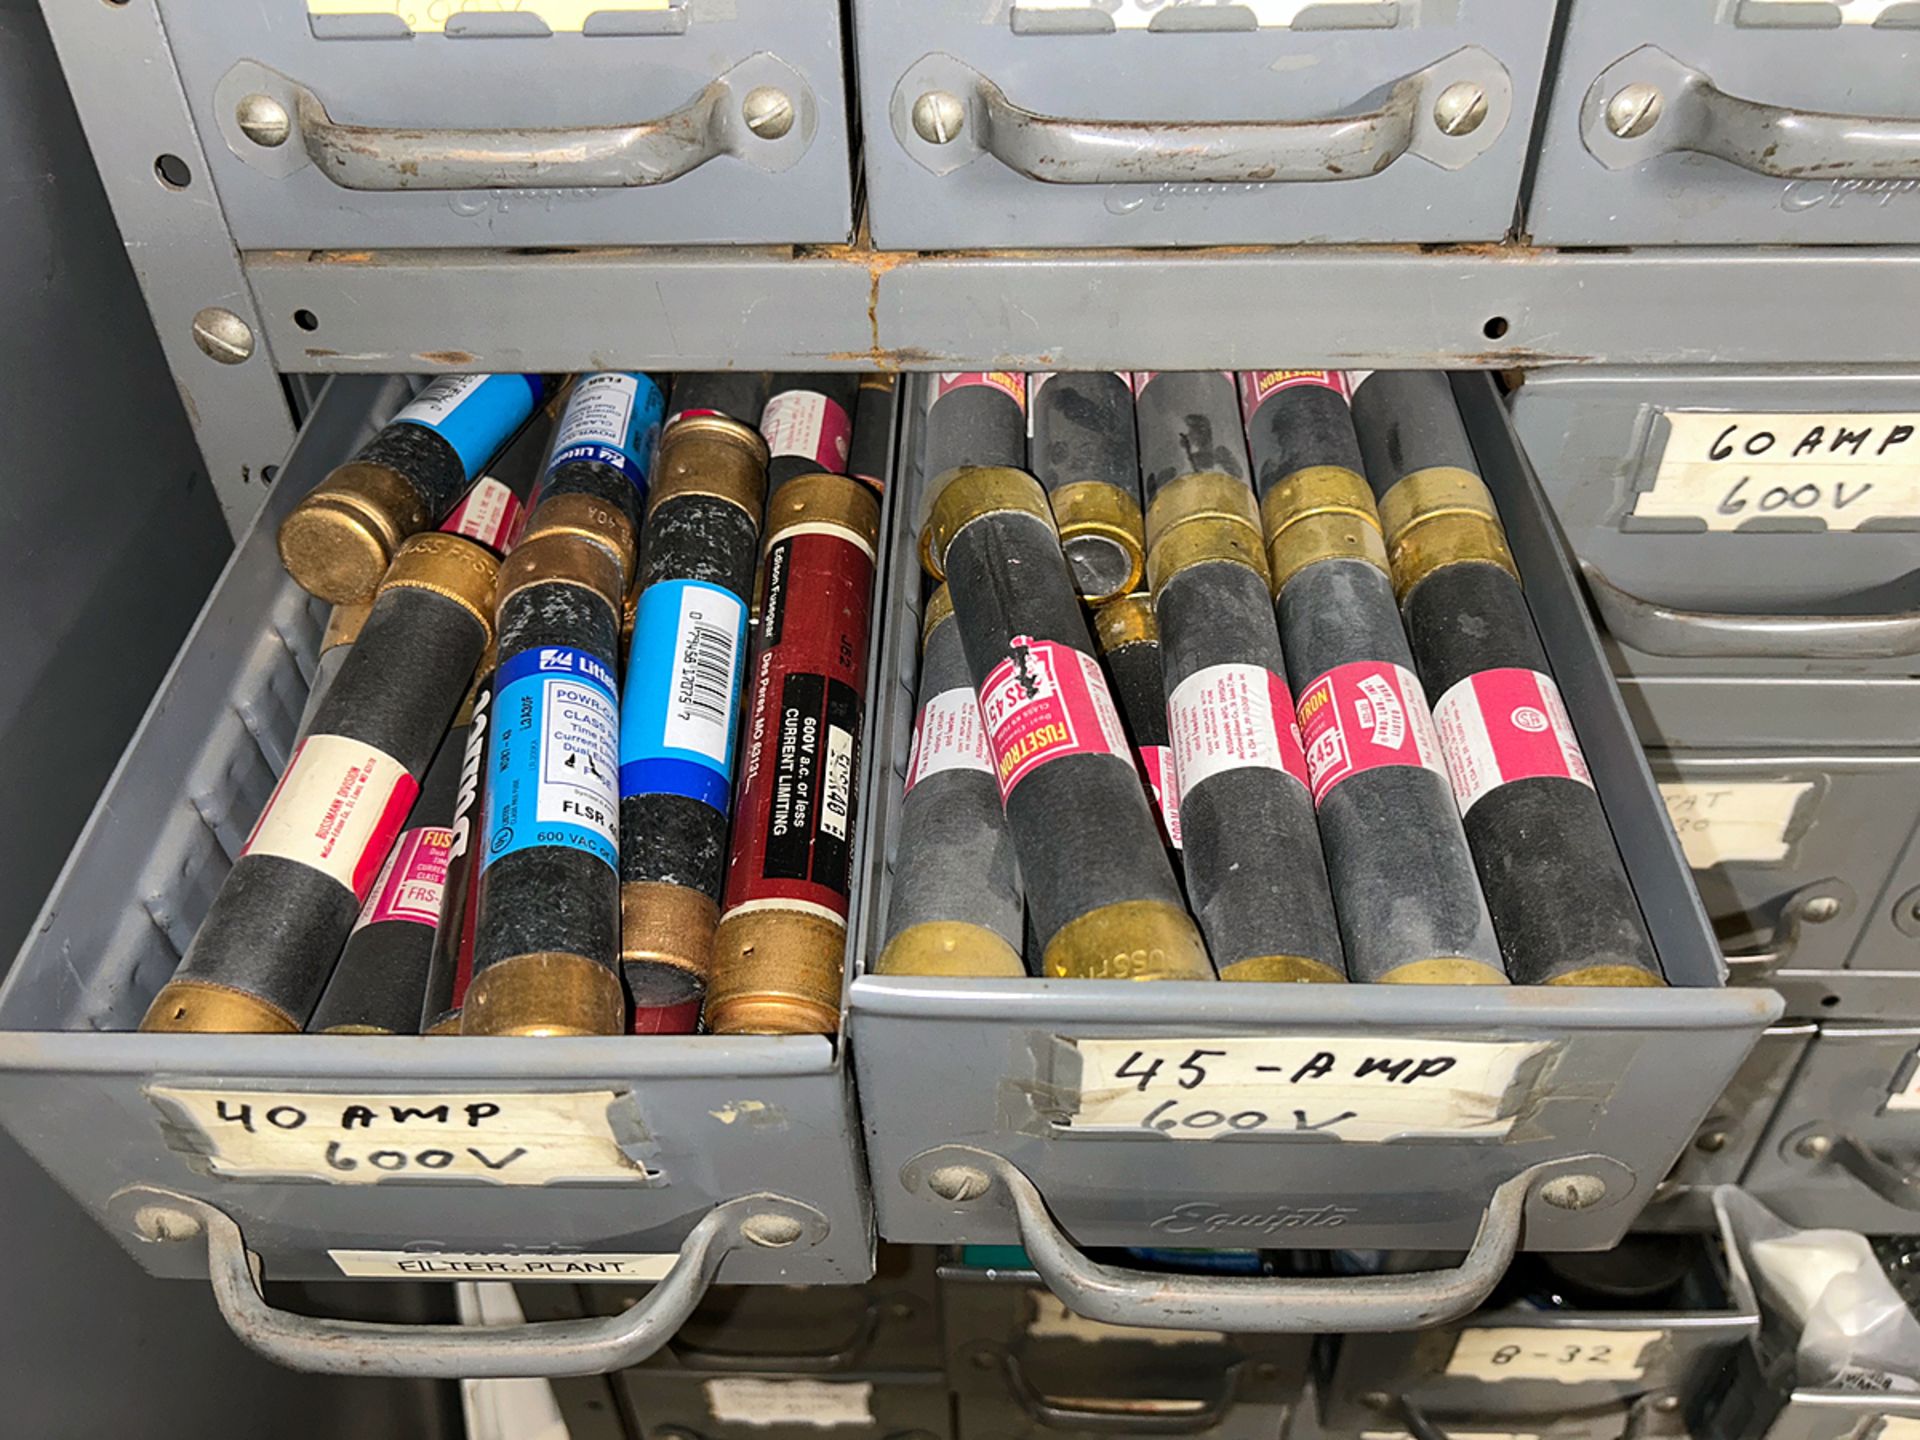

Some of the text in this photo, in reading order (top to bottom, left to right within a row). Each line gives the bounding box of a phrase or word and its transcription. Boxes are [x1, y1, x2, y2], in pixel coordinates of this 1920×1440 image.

[1709, 424, 1914, 461] 60 AMP
[764, 546, 785, 638] Edison Fusegear
[760, 652, 772, 677] Des
[1199, 688, 1207, 704] WITH
[1217, 677, 1227, 703] DIVISION
[563, 708, 606, 733] CLASS
[988, 698, 1003, 726] 45
[1201, 707, 1210, 733] REPLACE
[1206, 688, 1220, 749] AN ORDINARY FUSE
[554, 731, 598, 751] Current
[570, 723, 599, 740] Time
[1223, 721, 1234, 755] BUSSMANN
[563, 742, 590, 756] Dual
[998, 721, 1067, 778] FUSETRON
[1314, 735, 1335, 762] 45
[772, 708, 800, 836] CURRENT LIMITING
[793, 716, 817, 828] 600V a.c. or less
[314, 764, 360, 840] BUSSMANN DIVISION
[562, 800, 606, 826] FLSR
[537, 831, 564, 843] 600
[569, 832, 599, 851] VAC
[416, 872, 440, 882] CLASS
[1115, 1049, 1226, 1092] 45
[217, 1100, 501, 1133] 40 AMP
